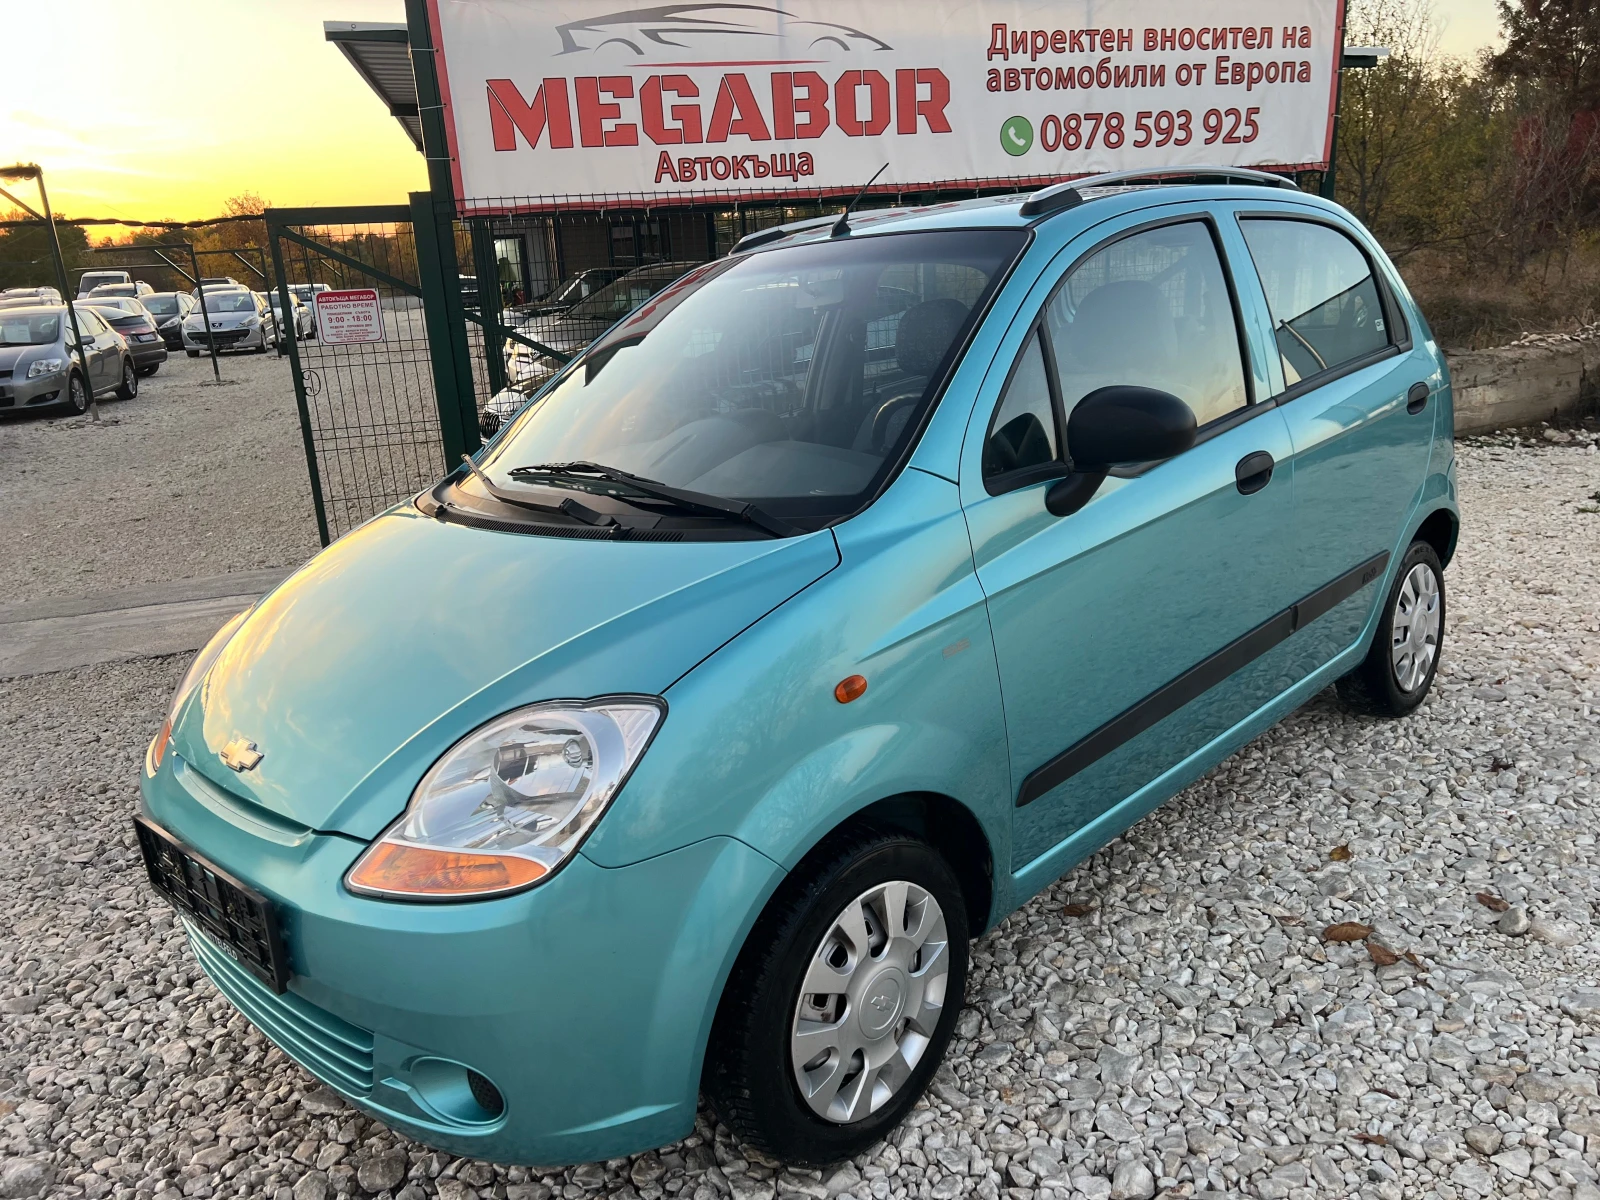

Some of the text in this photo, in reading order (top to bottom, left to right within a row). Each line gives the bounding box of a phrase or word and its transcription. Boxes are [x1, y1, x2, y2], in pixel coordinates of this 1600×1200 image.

[987, 23, 1312, 61] Директен вносител на
[986, 56, 1312, 92] автомобили от Европа
[486, 67, 953, 151] MEGABOR
[1040, 107, 1261, 153] 0878 593 925
[655, 150, 815, 183] Автокъща
